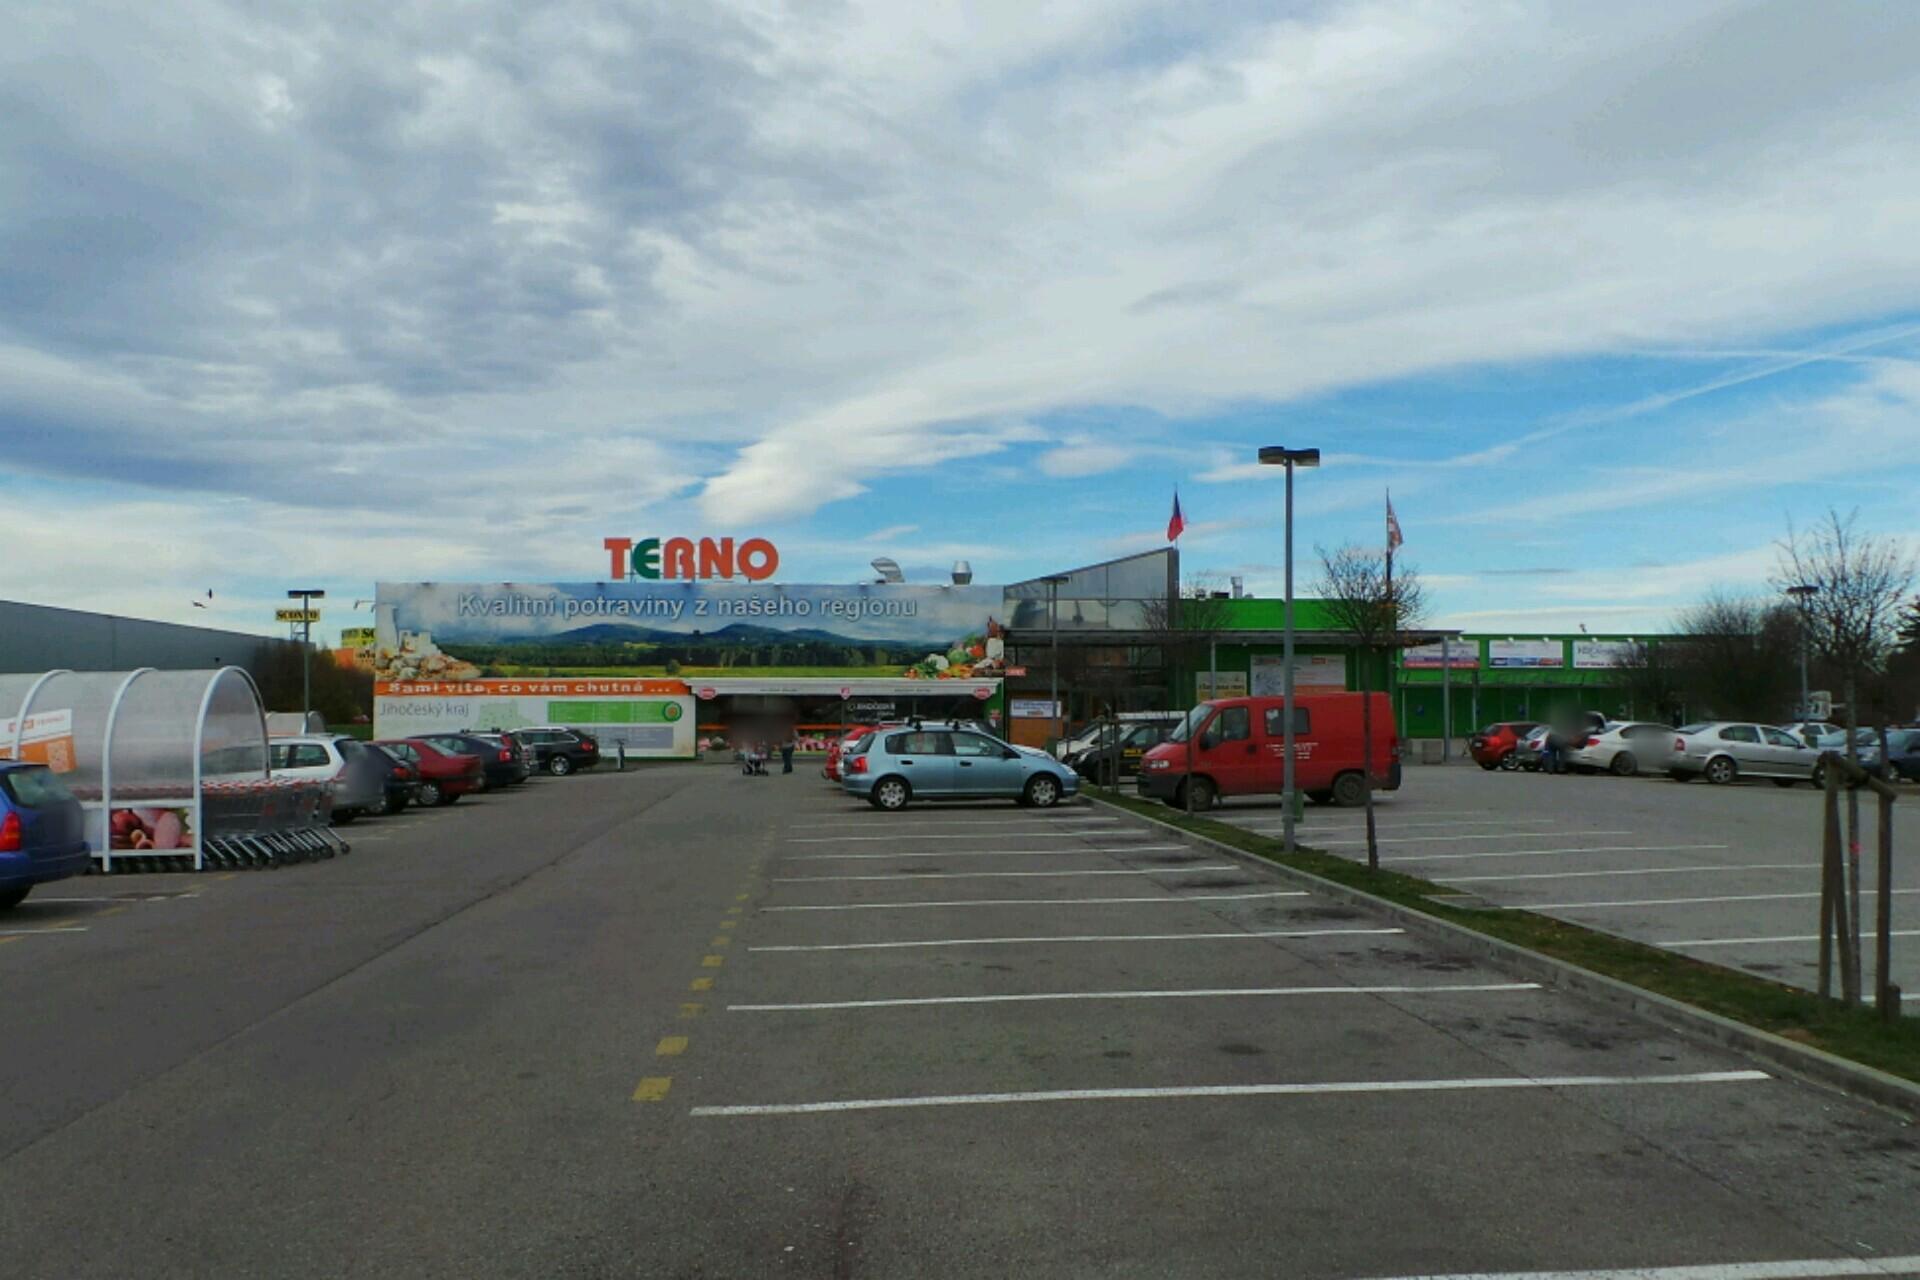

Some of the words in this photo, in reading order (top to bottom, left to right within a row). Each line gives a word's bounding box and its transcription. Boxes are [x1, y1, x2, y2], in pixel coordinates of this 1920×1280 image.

[604, 537, 779, 580] TERNO
[458, 592, 556, 617] Kvalitní
[563, 595, 683, 620] potraviny
[694, 600, 708, 616] z
[717, 594, 811, 616] našeho
[820, 596, 917, 620] regionu
[276, 610, 318, 620] SCONO
[498, 684, 522, 692] co
[574, 681, 644, 692] chutná
[379, 703, 441, 717] Jihočeský
[446, 703, 469, 716] kraj
